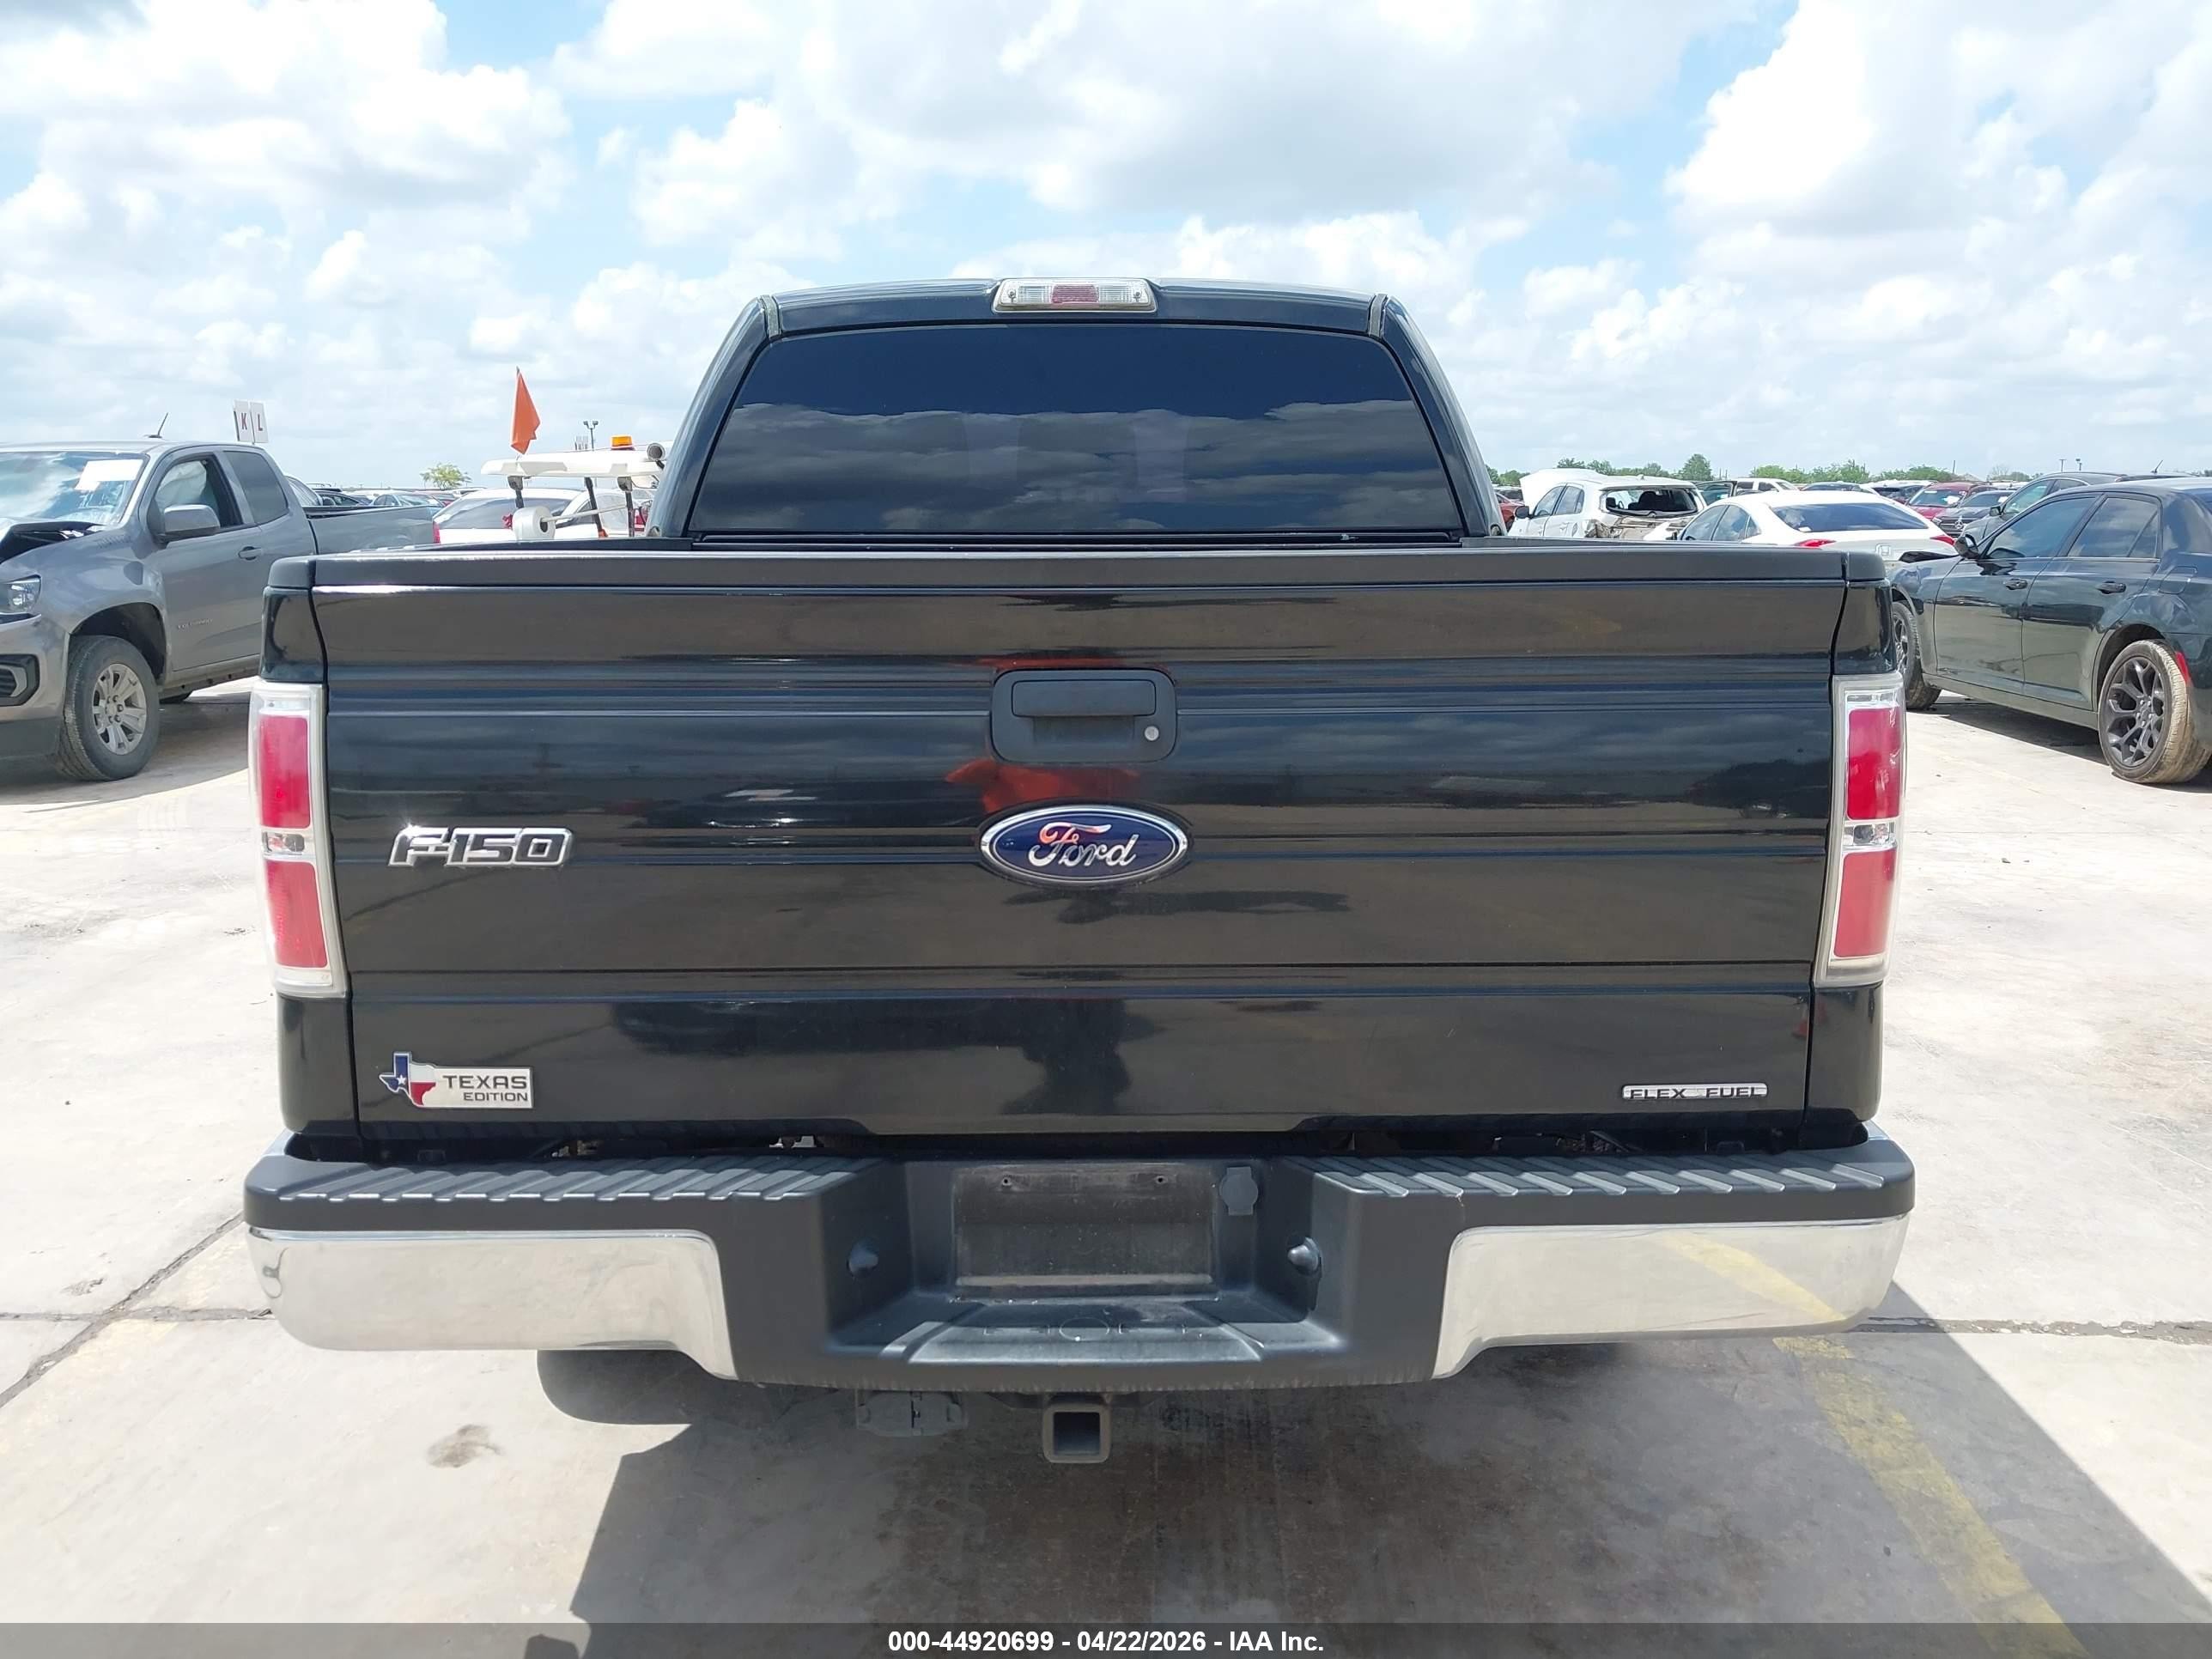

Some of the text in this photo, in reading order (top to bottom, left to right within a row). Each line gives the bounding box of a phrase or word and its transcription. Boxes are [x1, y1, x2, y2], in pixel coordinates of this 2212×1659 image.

[240, 412, 247, 430] K
[258, 413, 264, 431] L
[388, 826, 572, 867] F-150
[1028, 822, 1139, 866] Ford
[442, 1075, 527, 1090] TEXAS
[463, 1092, 528, 1102] EDITION
[1631, 1087, 1763, 1099] FLEX FUEL
